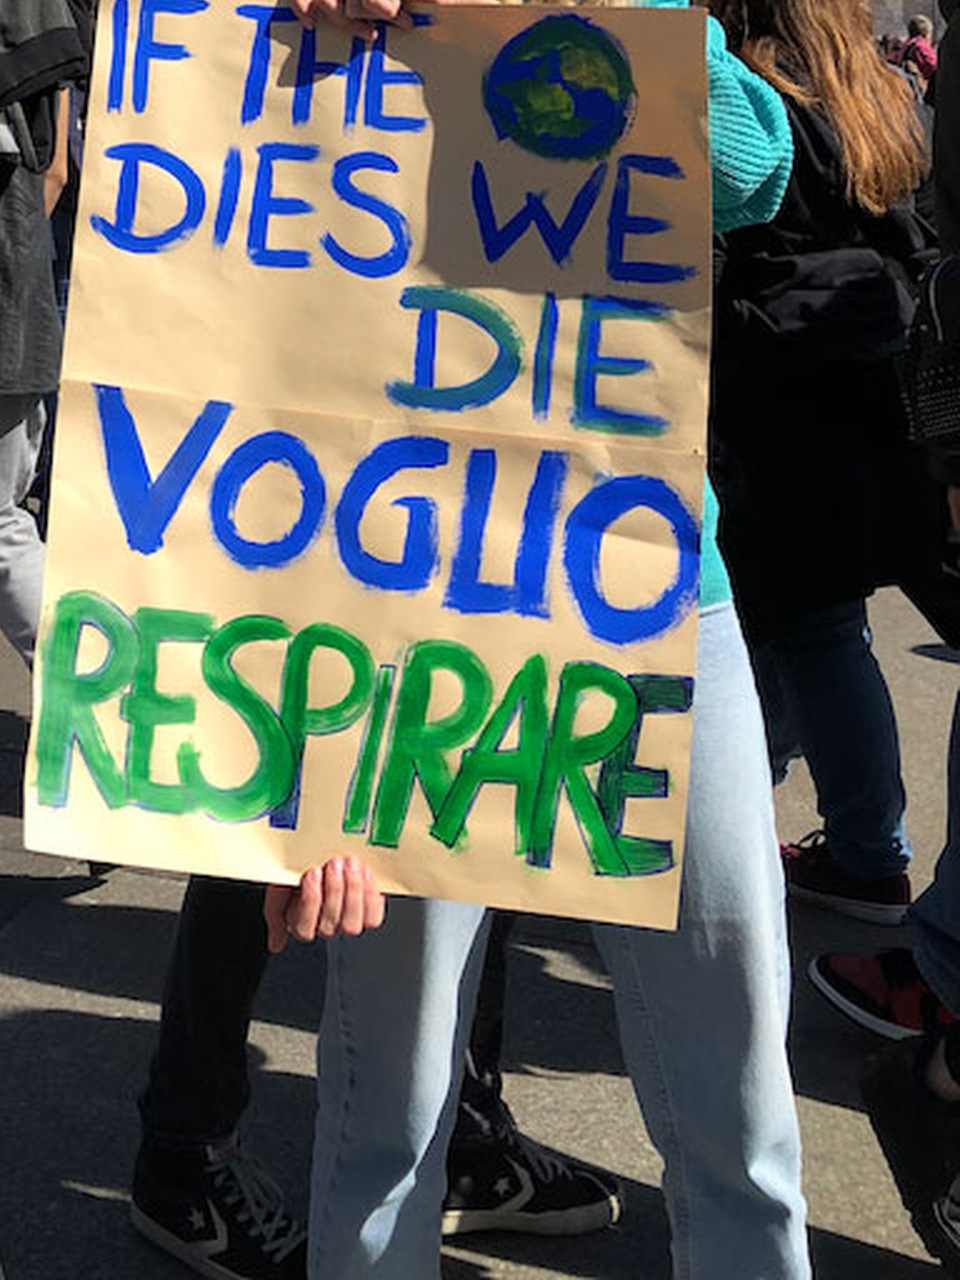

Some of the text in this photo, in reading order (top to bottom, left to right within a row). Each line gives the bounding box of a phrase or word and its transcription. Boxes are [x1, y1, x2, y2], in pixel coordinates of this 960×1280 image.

[236, 5, 434, 133] THE
[91, 143, 696, 283] DIES WE
[386, 286, 672, 435] DIE
[92, 383, 700, 645] VOGLIO
[37, 590, 694, 876] RESPIRARE
